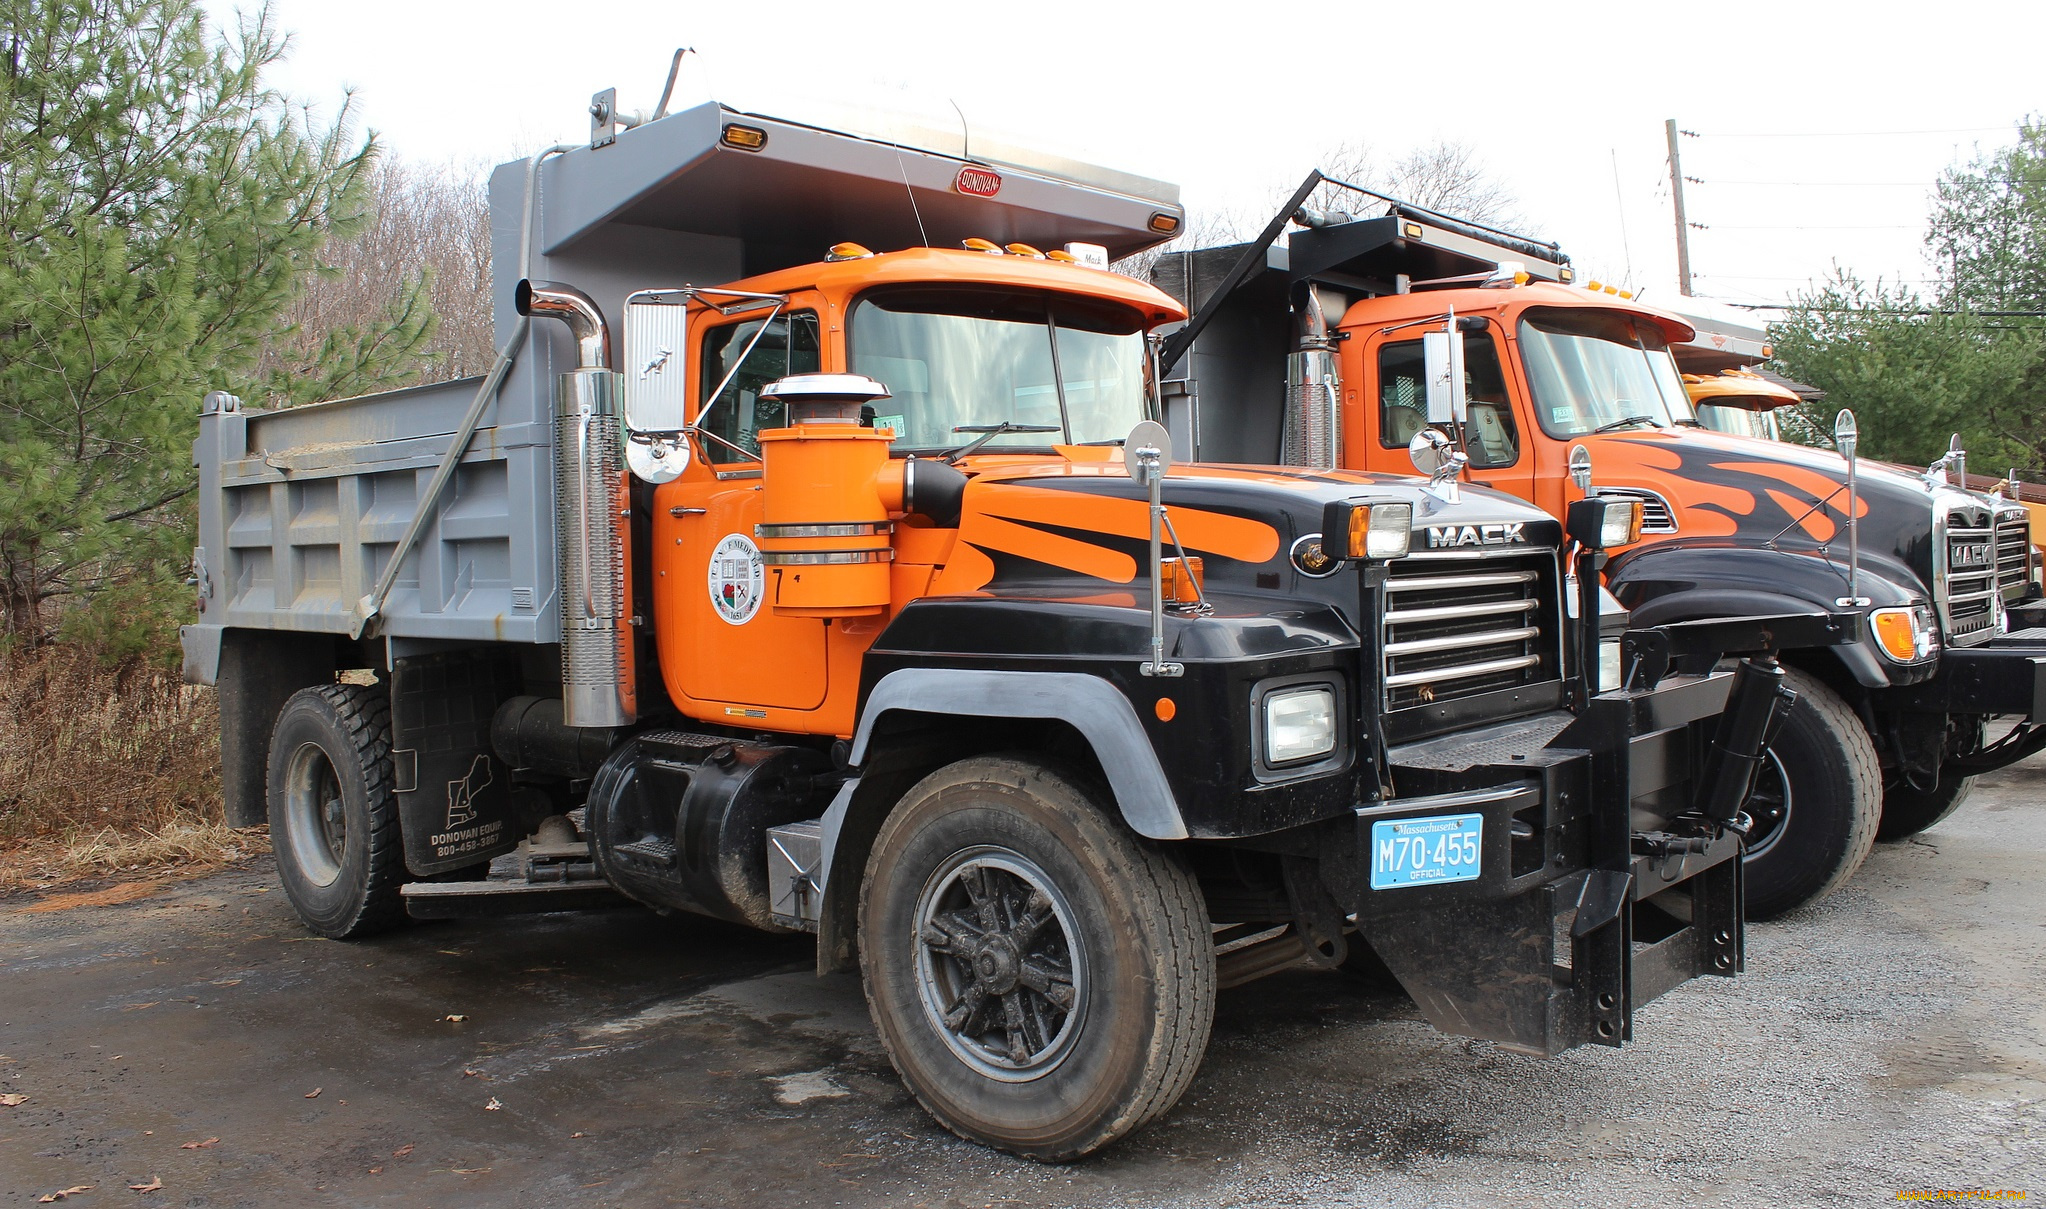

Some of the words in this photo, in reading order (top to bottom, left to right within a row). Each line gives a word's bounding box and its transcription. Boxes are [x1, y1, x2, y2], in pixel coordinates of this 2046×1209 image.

[961, 171, 999, 193] DONOVAN
[1424, 523, 1525, 549] MACK
[734, 540, 760, 578] MEDFELD
[1951, 545, 1992, 565] MACK
[773, 568, 783, 604] 7
[793, 574, 801, 583] 4
[730, 611, 742, 620] 1651
[431, 828, 478, 846] DONOVAN
[480, 820, 503, 835] EQUIP.
[1398, 822, 1458, 835] Massachusetts
[1410, 868, 1446, 880] OFFICIAL
